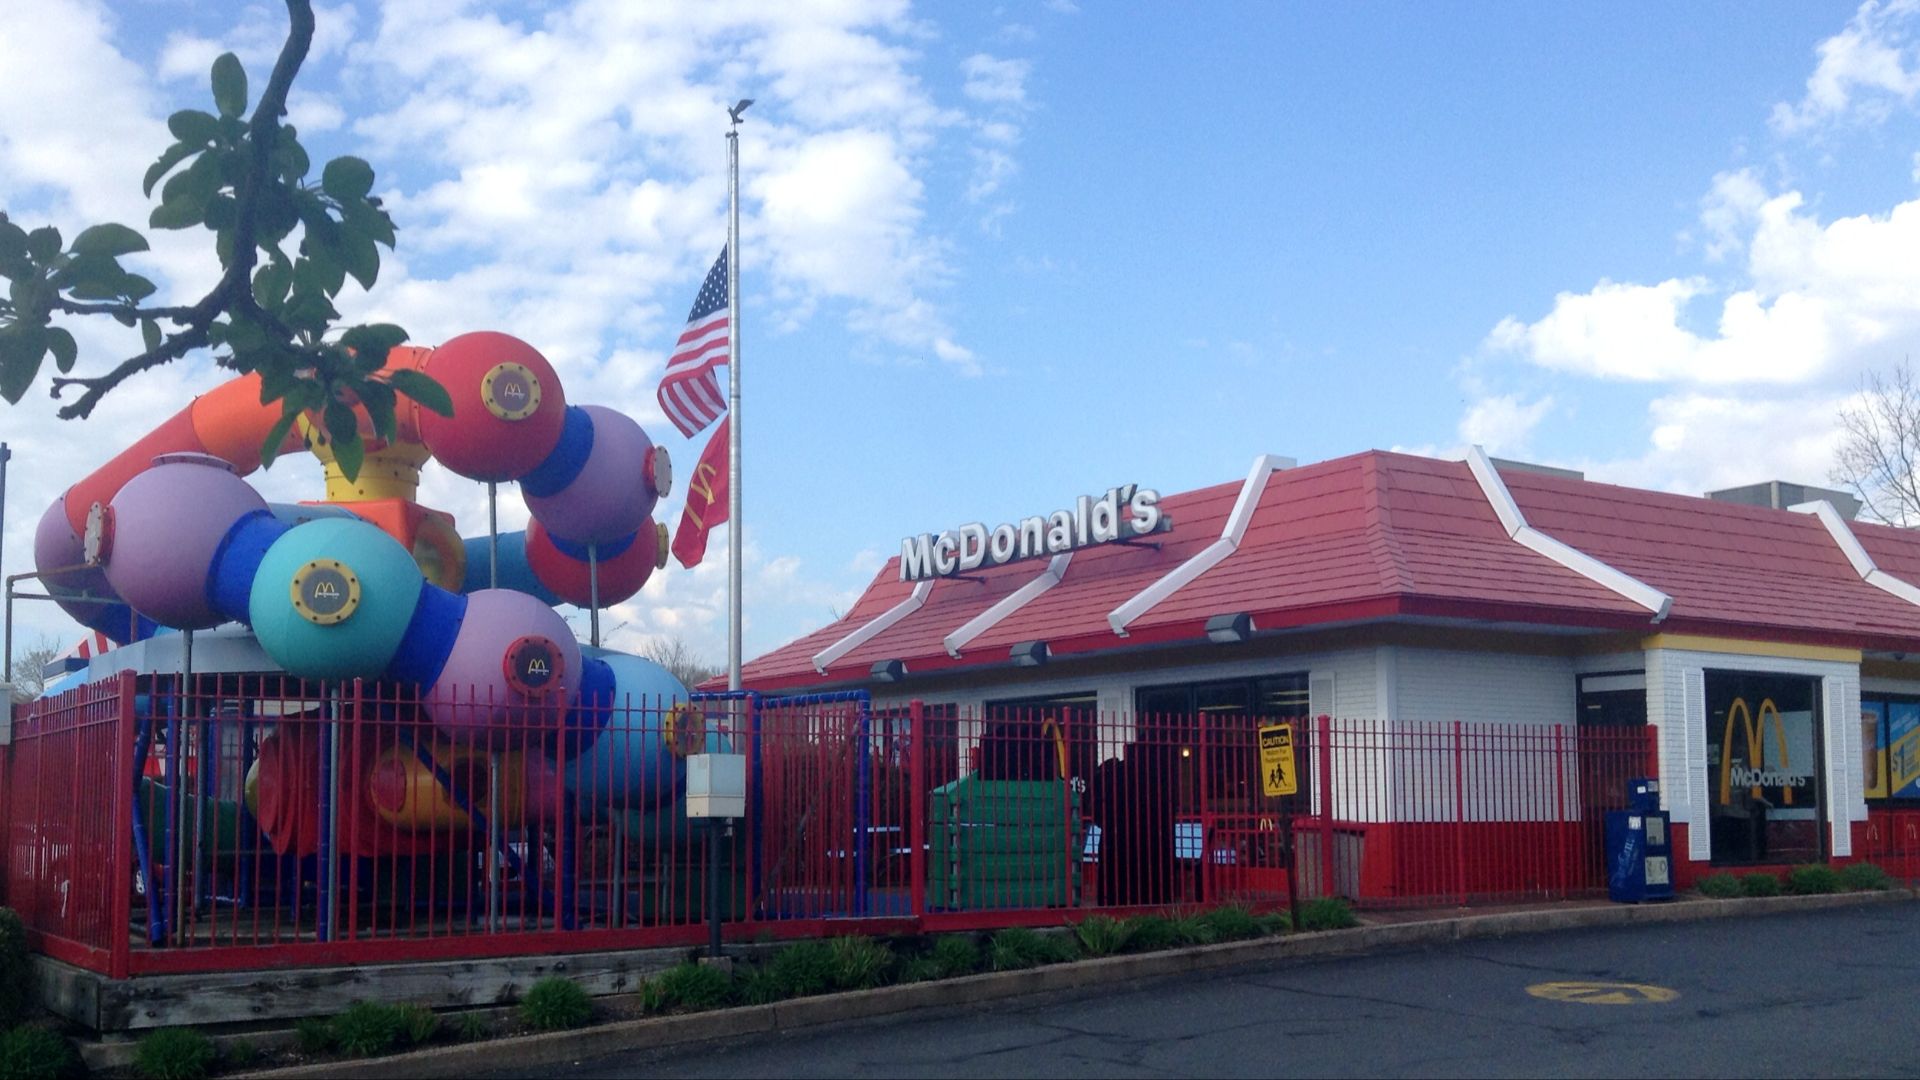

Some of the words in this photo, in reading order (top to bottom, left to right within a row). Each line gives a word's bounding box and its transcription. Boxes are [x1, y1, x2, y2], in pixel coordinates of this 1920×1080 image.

[900, 484, 1161, 582] McDonald's
[1262, 736, 1289, 747] CAUTION
[1730, 767, 1806, 787] McDonalds
